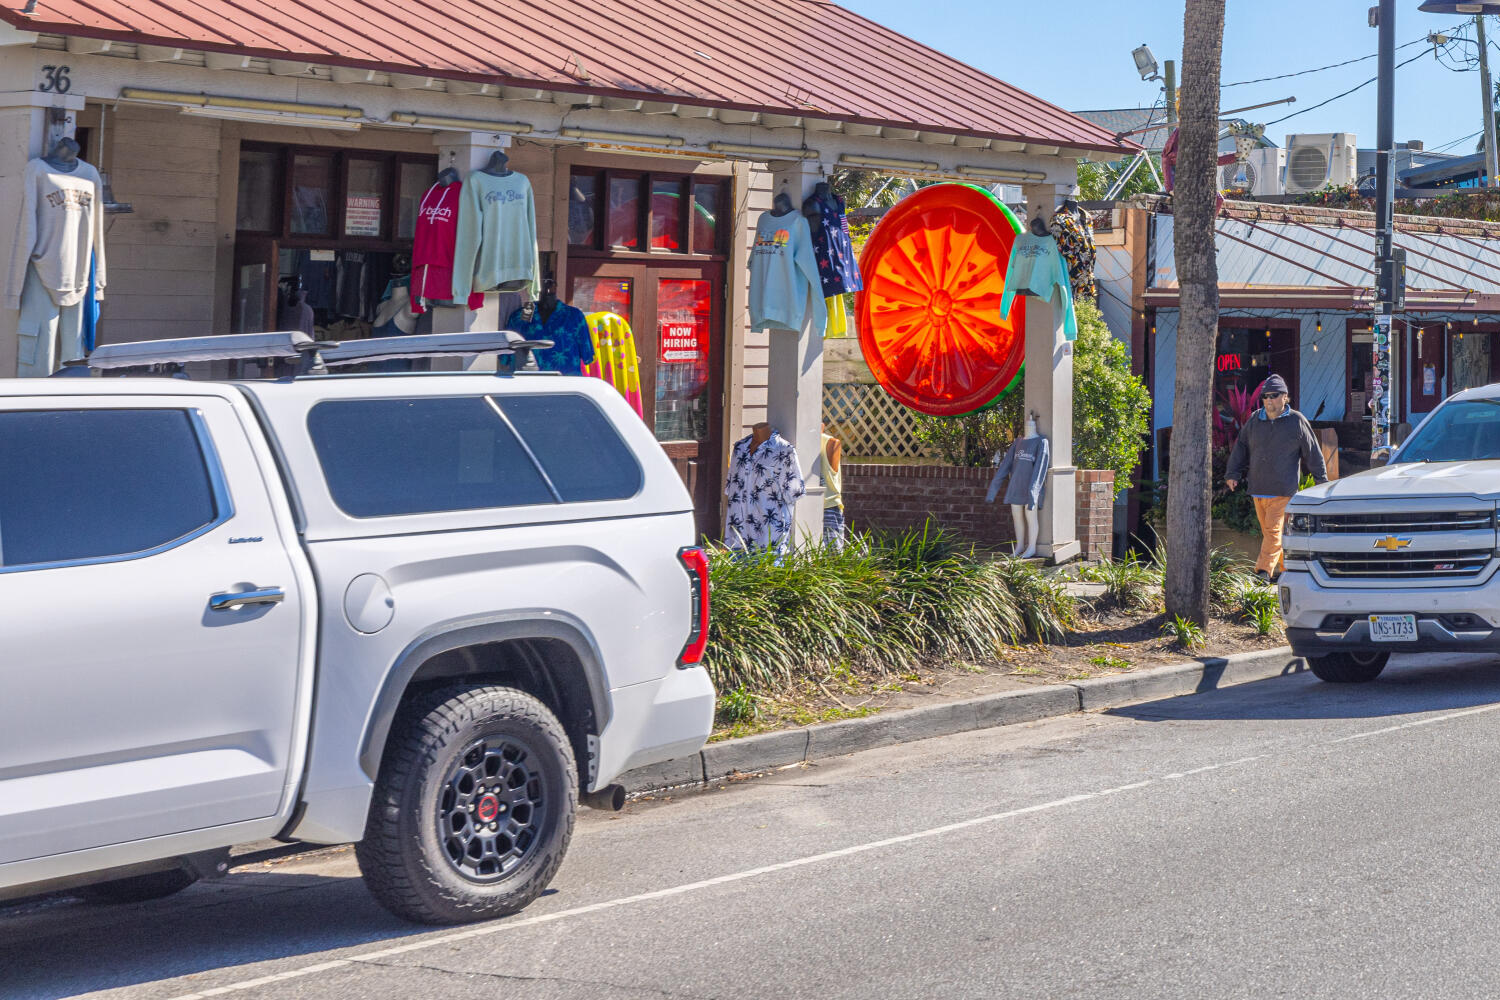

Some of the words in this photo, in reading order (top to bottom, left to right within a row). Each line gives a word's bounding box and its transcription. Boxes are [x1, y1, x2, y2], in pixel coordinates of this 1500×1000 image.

[39, 64, 71, 94] 36
[347, 198, 380, 209] WARNING
[669, 327, 692, 337] NOW
[663, 338, 697, 348] HIRING
[1217, 353, 1241, 371] OPEN
[1372, 621, 1414, 635] UNS-1733
